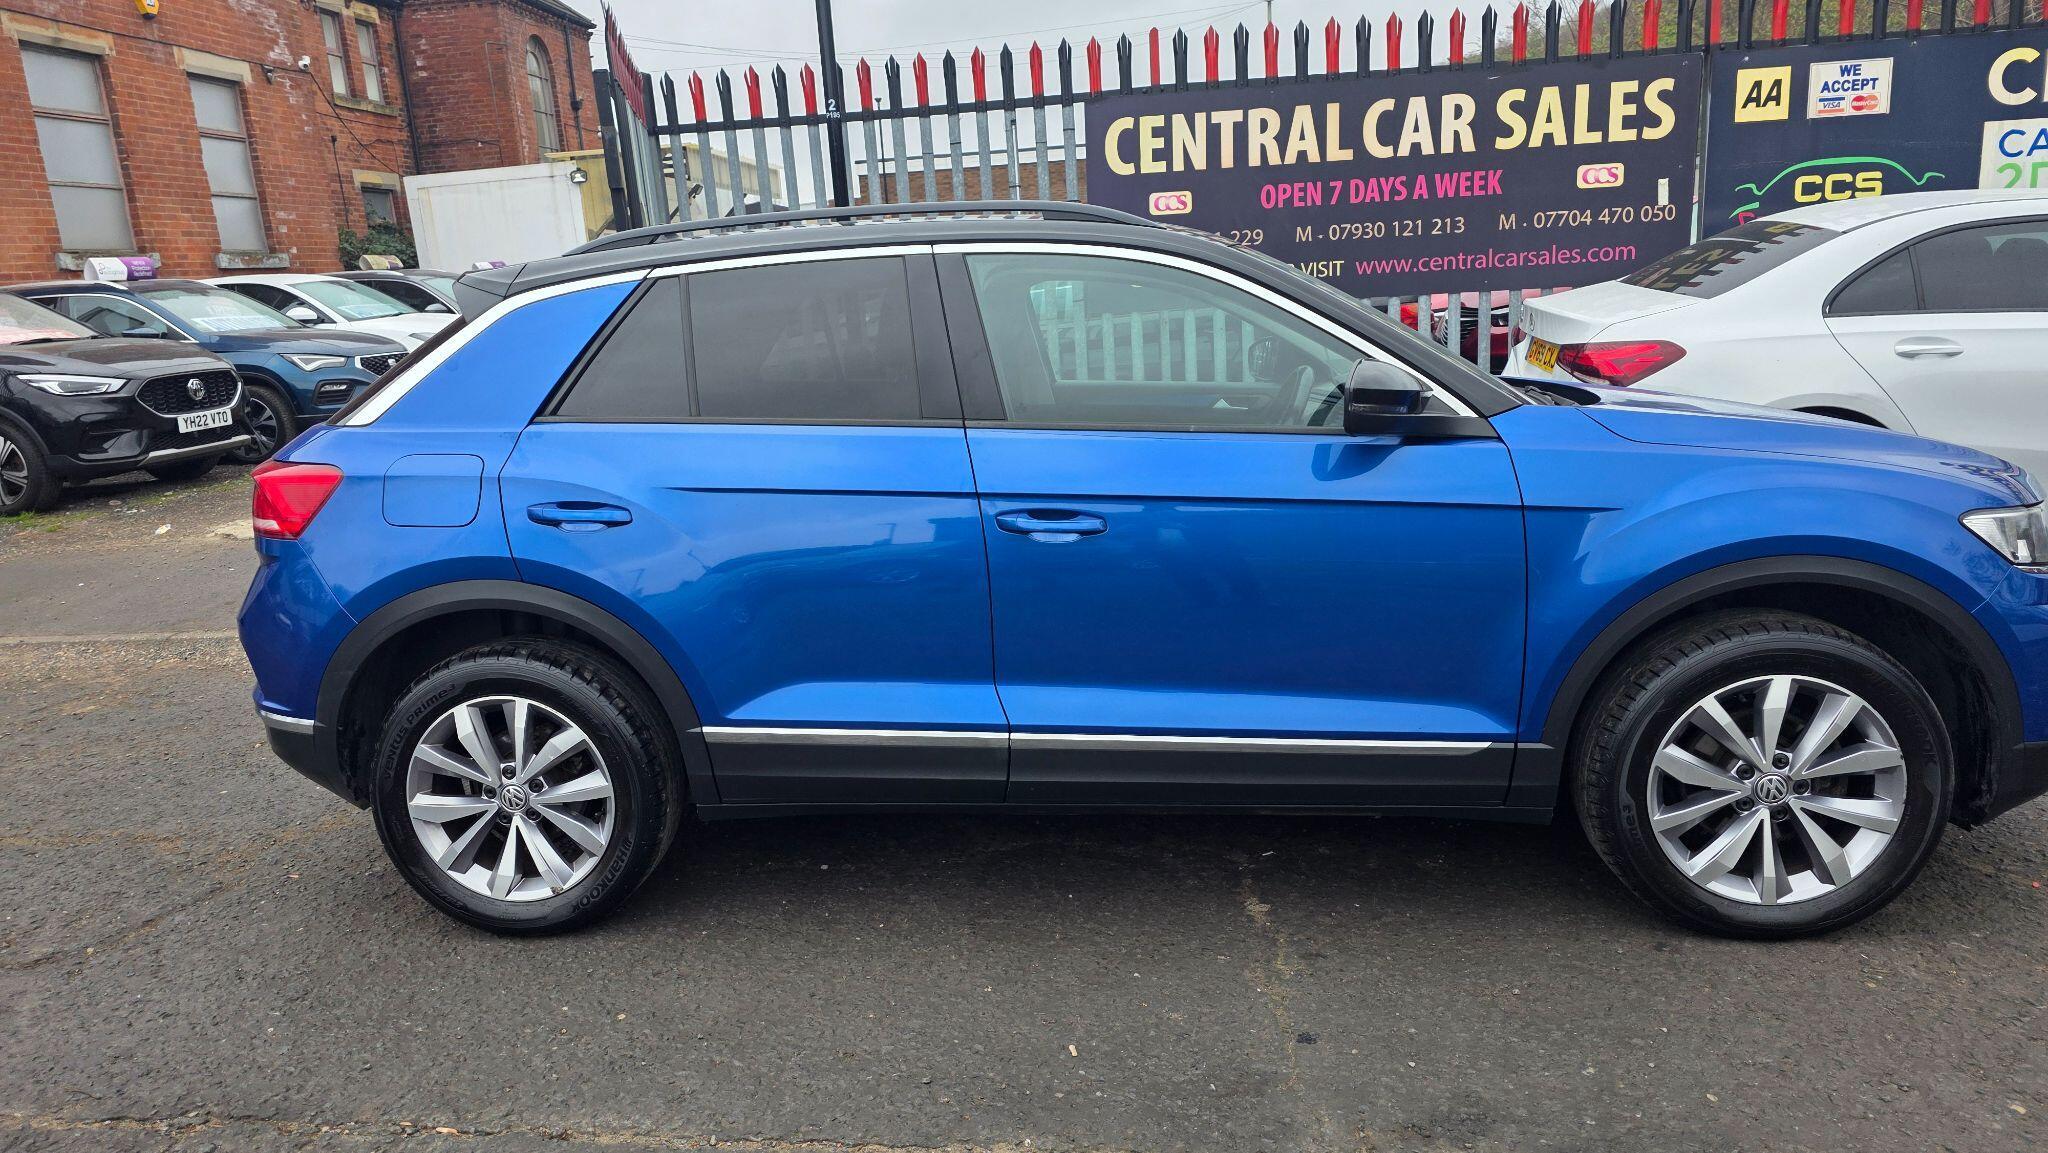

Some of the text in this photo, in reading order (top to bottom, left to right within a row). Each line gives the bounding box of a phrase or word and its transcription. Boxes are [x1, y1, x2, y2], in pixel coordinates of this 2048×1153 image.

[1840, 64, 1862, 77] WE
[1741, 79, 1782, 109] AA
[1820, 78, 1879, 93] ACCEPT
[828, 98, 836, 111] 2
[1104, 77, 1676, 176] CENTRAL CAR SALES
[1581, 166, 1619, 185] CCS
[1795, 171, 1883, 203] CCS
[1260, 169, 1504, 209] OPEN 7 DAYS A WEEK
[1153, 194, 1188, 212] CCS
[1296, 225, 1312, 242] M
[1328, 221, 1385, 241] 07930
[1392, 219, 1423, 237] 121
[1431, 216, 1465, 235] 213
[1499, 213, 1516, 231] M
[1533, 209, 1593, 228] 07704
[1598, 206, 1634, 226] 470
[1640, 204, 1676, 222] 050
[1301, 260, 1345, 278] VISIT
[1355, 244, 1636, 276] www.centralcarsales.com
[182, 411, 228, 430] YH22 VTO
